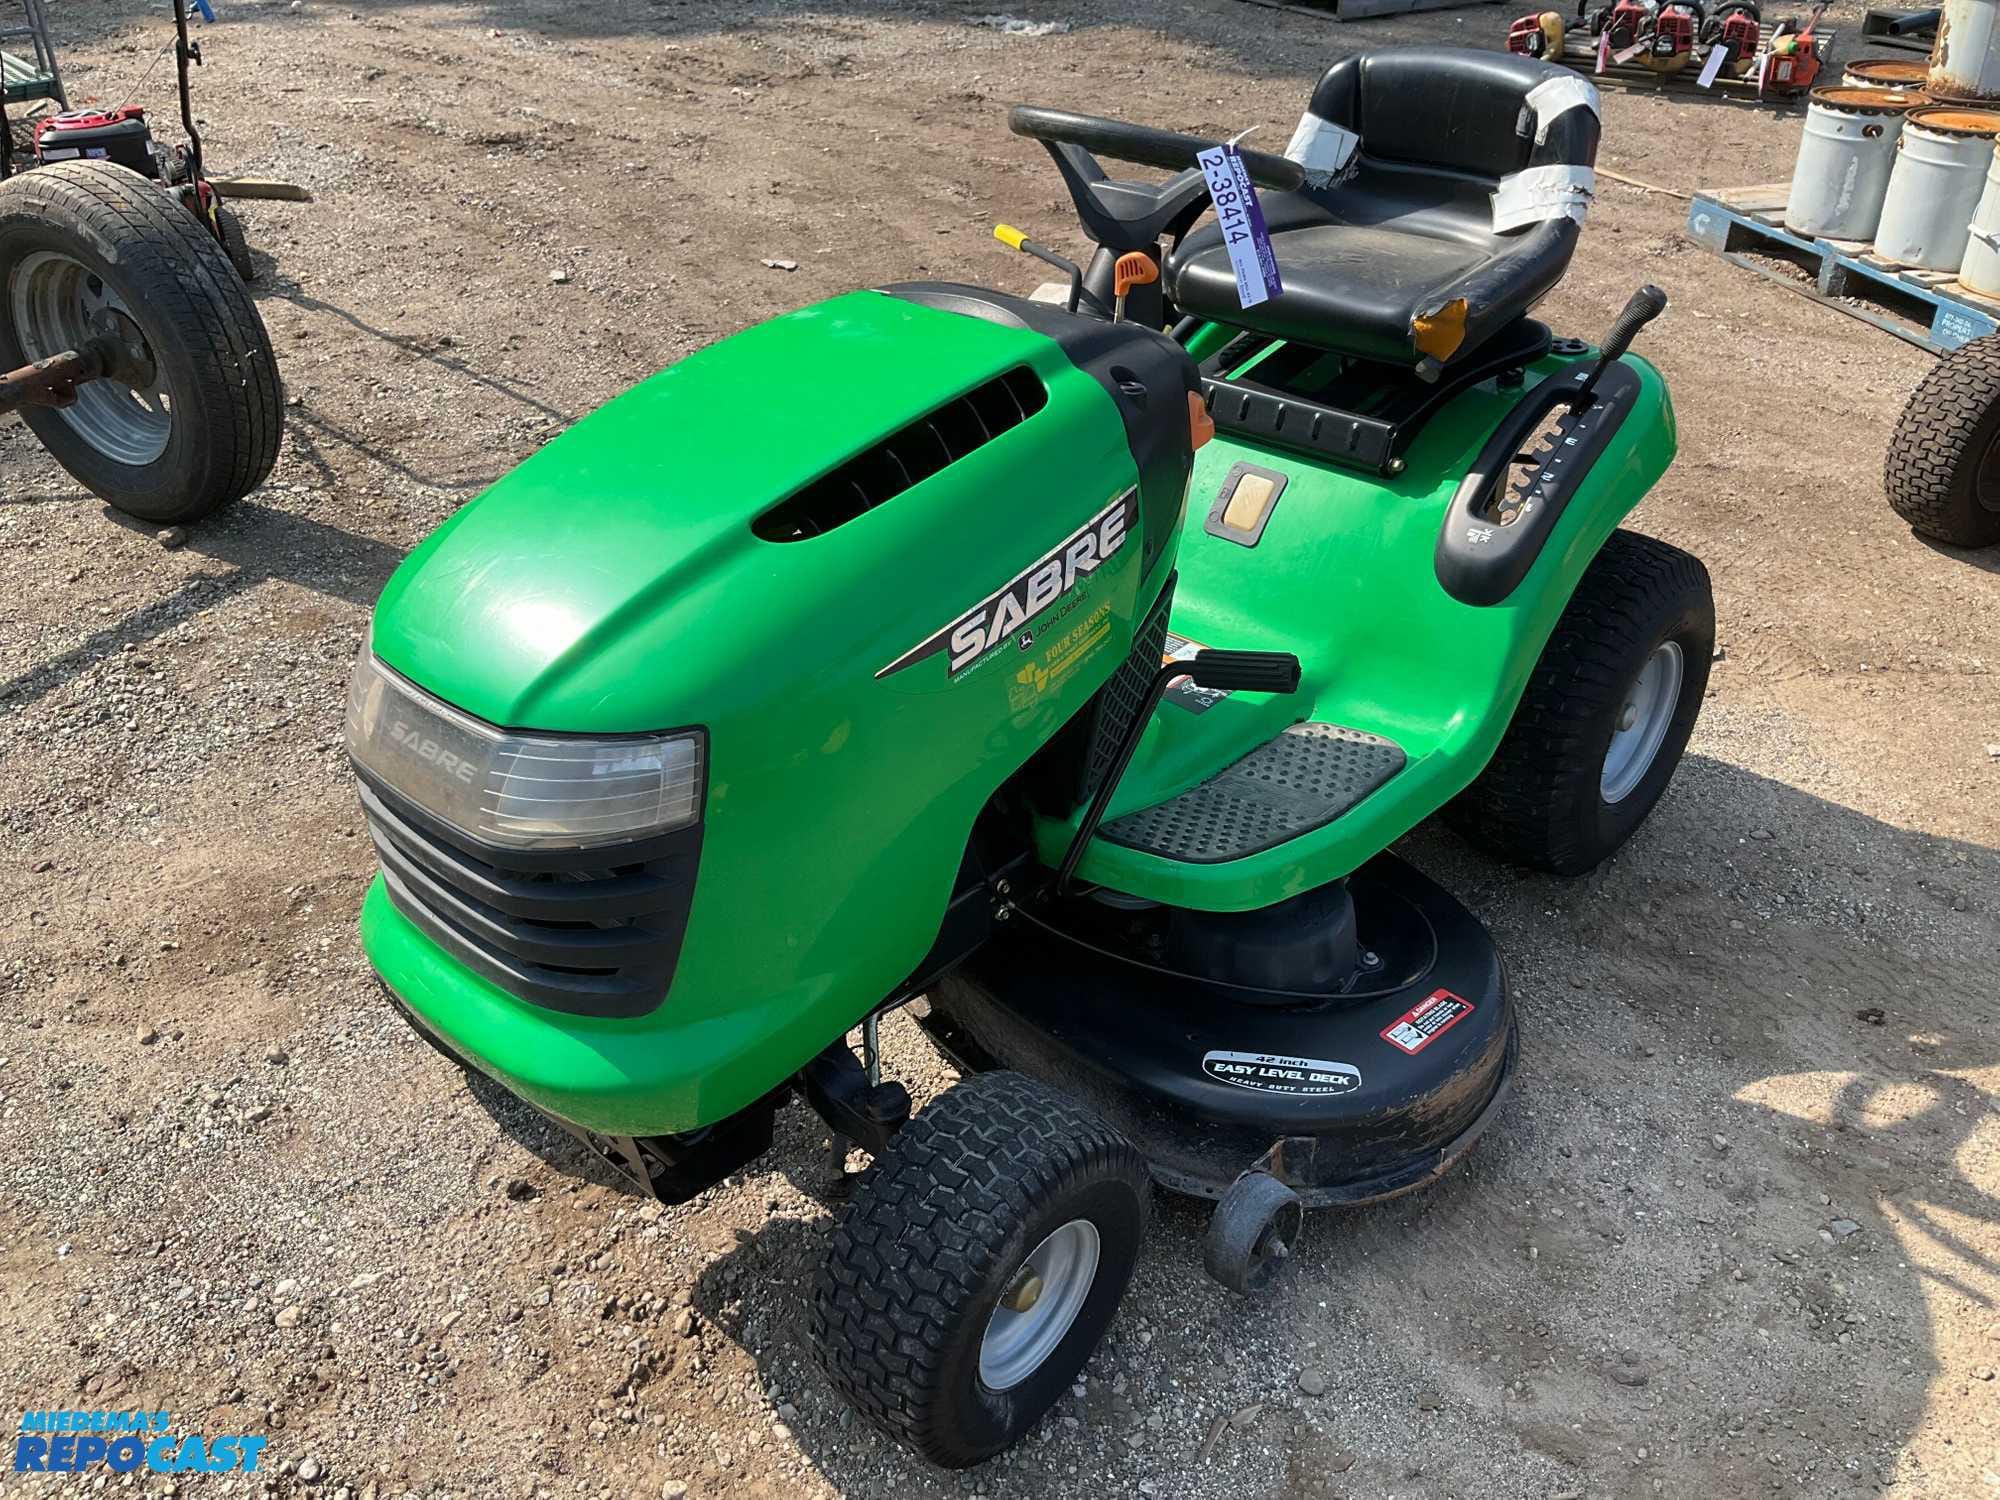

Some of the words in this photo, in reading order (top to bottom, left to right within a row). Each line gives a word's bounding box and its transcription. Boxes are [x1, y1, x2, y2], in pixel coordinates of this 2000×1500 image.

[1202, 155, 1249, 245] 2-38414
[1229, 155, 1254, 207] REPOCAST
[951, 503, 1126, 671] SABRE
[1036, 612, 1059, 637] JOHN
[1072, 599, 1111, 641] SEASONS
[953, 647, 1002, 683] MANUFACTURED
[389, 720, 478, 784] SABRE
[1213, 1063, 1256, 1075] EASY
[1258, 1067, 1305, 1081] LEVEL
[1309, 1072, 1350, 1086] DECK
[1255, 1055, 1275, 1063] 42
[1279, 1058, 1308, 1067] inch
[1230, 1076, 1263, 1088] HEAVY
[1268, 1084, 1297, 1092] DUTY
